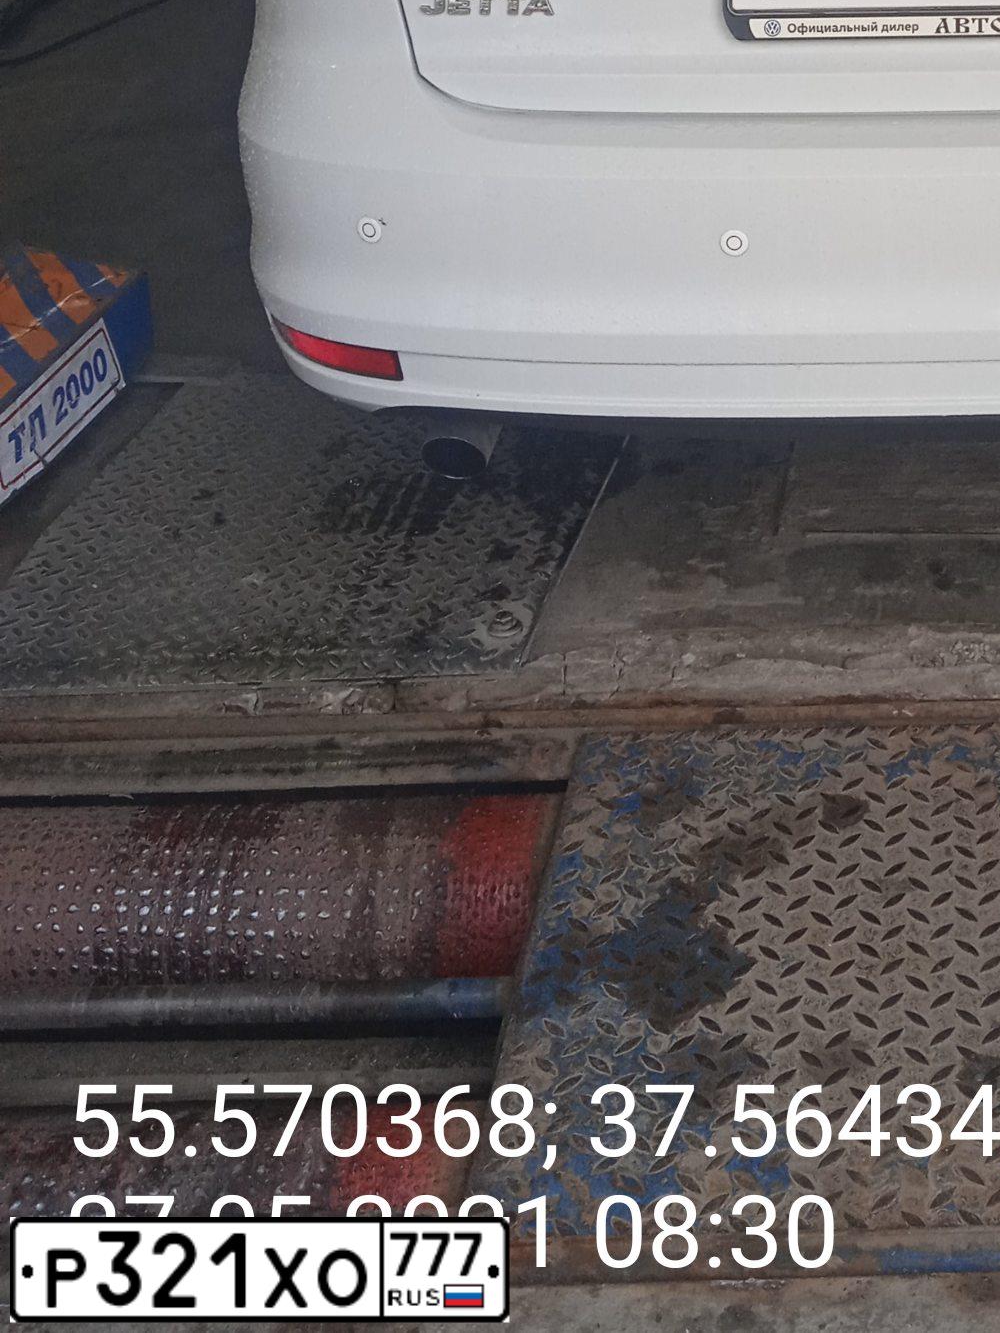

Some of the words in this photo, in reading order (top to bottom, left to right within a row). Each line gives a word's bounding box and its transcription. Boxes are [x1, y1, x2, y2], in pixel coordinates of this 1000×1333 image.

[787, 21, 878, 35] Официальный
[881, 21, 919, 34] дилер
[8, 404, 46, 463] ТП
[53, 348, 108, 425] 2000
